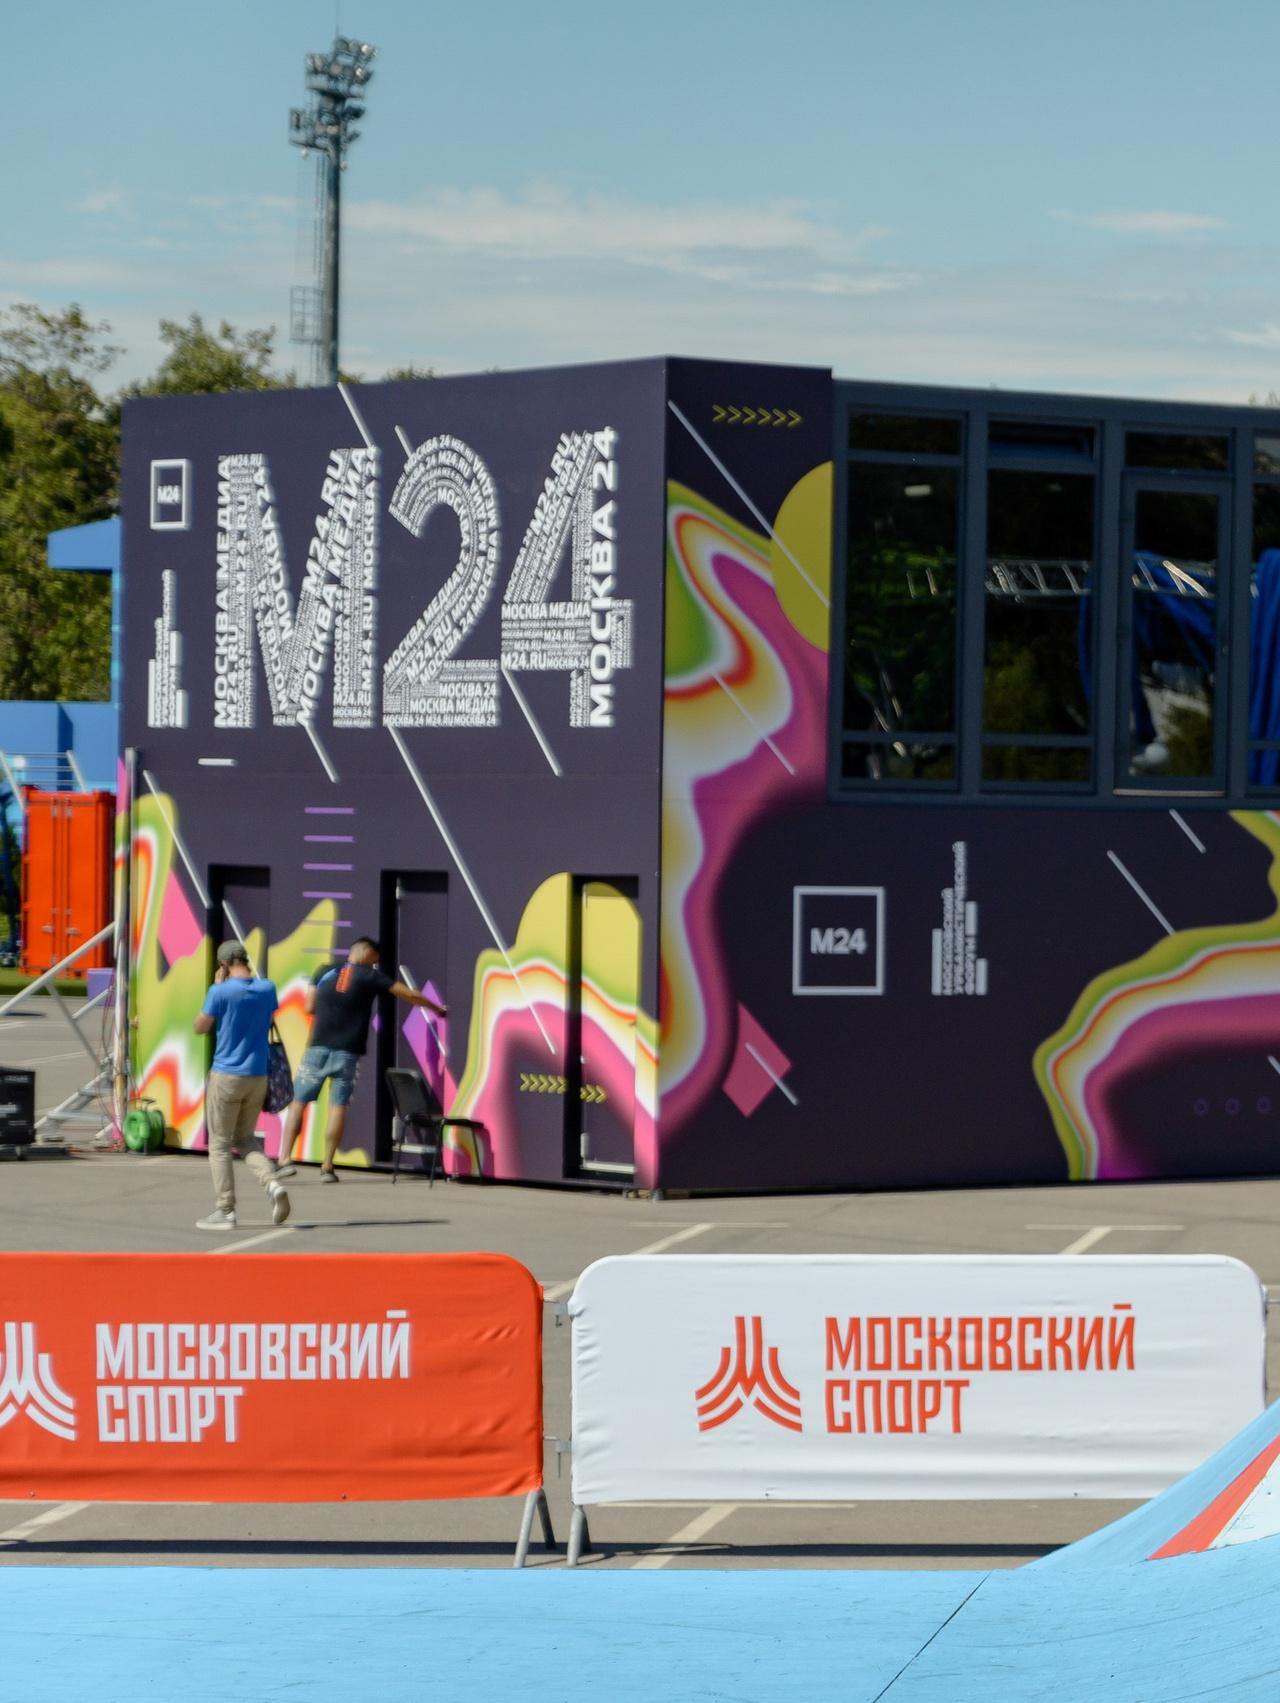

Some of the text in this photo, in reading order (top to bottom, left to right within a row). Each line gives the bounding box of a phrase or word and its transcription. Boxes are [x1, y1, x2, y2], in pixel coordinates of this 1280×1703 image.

[439, 434, 451, 449] 24
[157, 485, 181, 504] M24
[437, 487, 469, 549] МОСКВА
[529, 432, 571, 537] M24.RU
[543, 459, 576, 537] МОСКВА
[543, 432, 594, 565] МОСКВА МЕДИА
[237, 494, 249, 592] M24.RU
[253, 466, 293, 641] МОСКВА 24
[302, 449, 344, 600] M24.RU
[214, 456, 231, 728] МОСКВА МЕДИА
[295, 583, 338, 729] МОСКВА
[328, 448, 367, 580] МЕДИА
[361, 446, 376, 691] M24.RU МОСКВА 24
[590, 426, 618, 728] МОСКВА 24
[383, 618, 425, 677] МОСКВА
[423, 570, 461, 624] МЕДИА
[501, 603, 548, 620] МОСКВА
[549, 602, 591, 621] МЕДИА
[544, 629, 576, 642] M24.RU
[226, 624, 239, 728] M24.RU
[263, 608, 287, 712] МОСКВА
[406, 613, 454, 683] M24.RU
[420, 627, 461, 686] МОСКВА
[501, 652, 547, 670] M24.RU
[333, 691, 371, 706] M24.RU
[383, 714, 413, 727] МОСКВА
[415, 714, 424, 727] 24
[454, 714, 485, 727] МОСКВА
[487, 714, 497, 727] 24
[410, 698, 496, 716] МОСКВА МЕДИА
[440, 682, 481, 698] МОСКВА
[484, 682, 497, 698] 24
[811, 927, 866, 954] M24
[96, 1310, 409, 1380] МОСКОВСКИЙ
[825, 1303, 1137, 1371] МОСКОВСКИЙ
[96, 1386, 244, 1442] СПОРТ
[826, 1379, 970, 1434] СПОРТ
